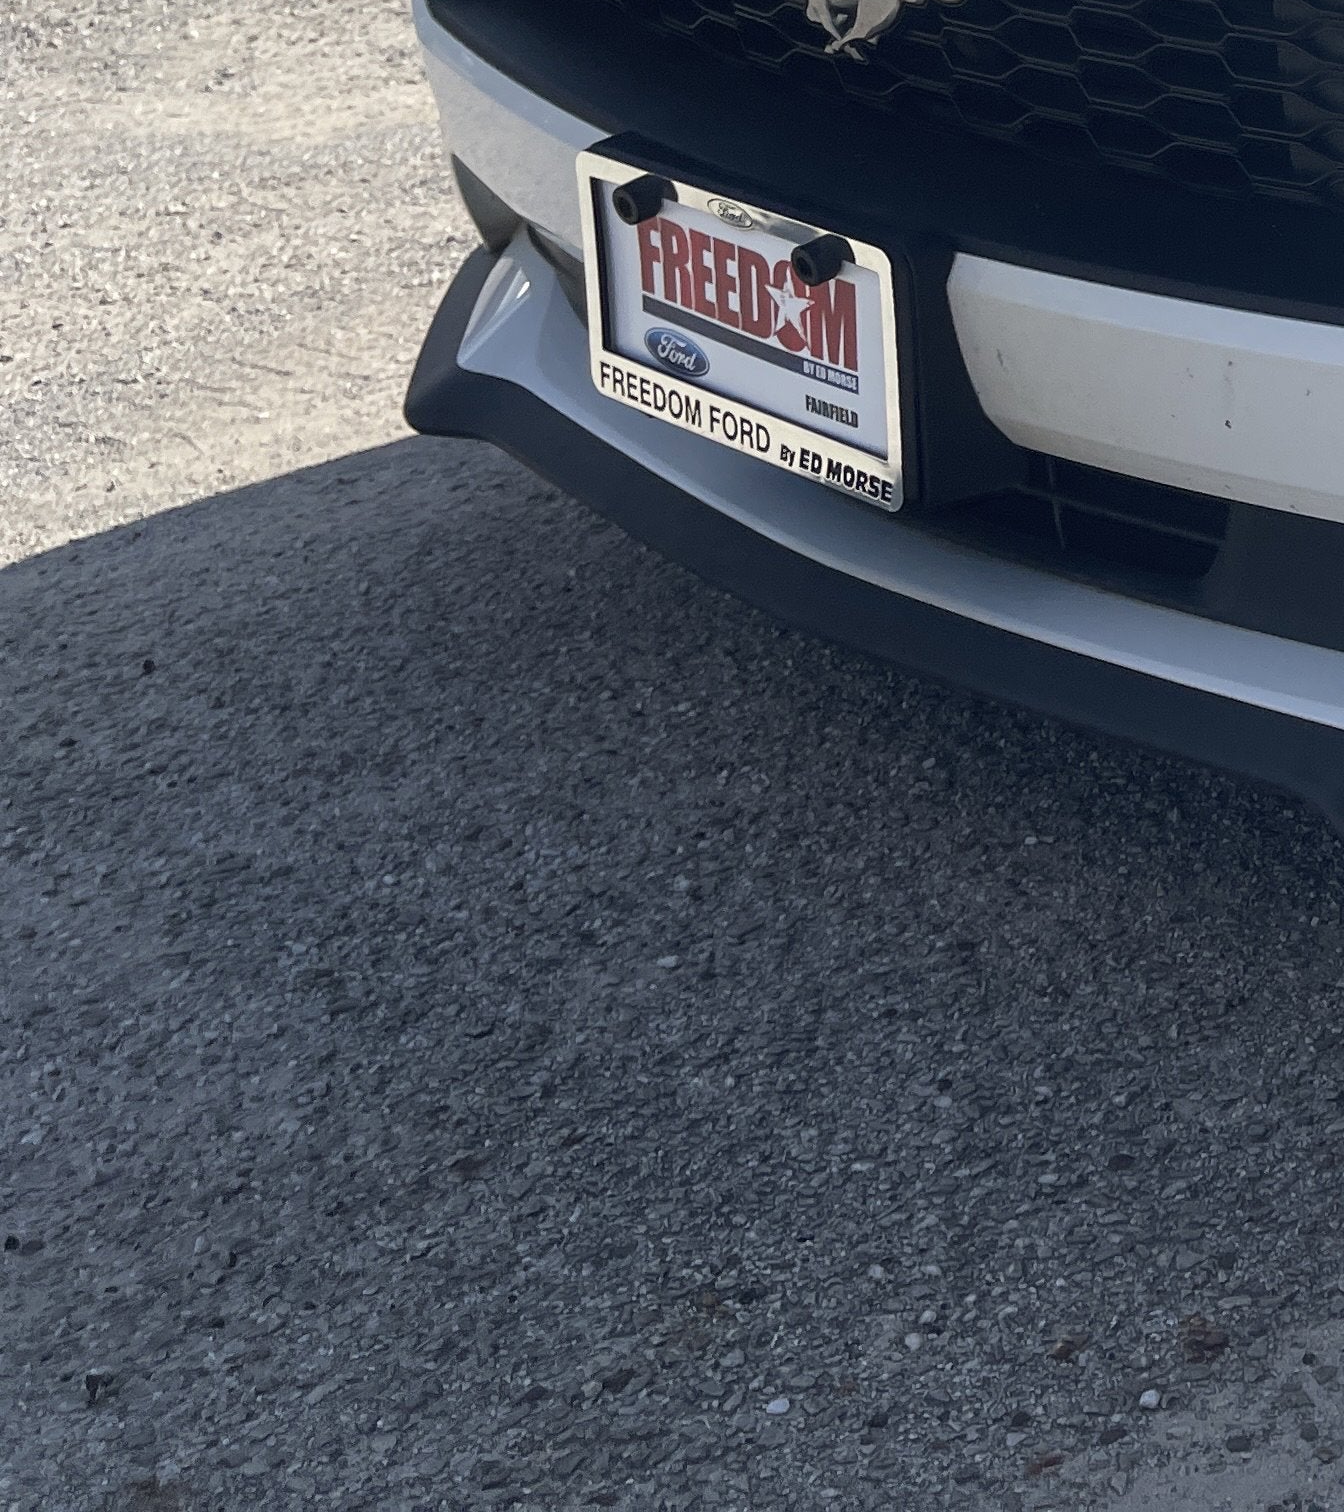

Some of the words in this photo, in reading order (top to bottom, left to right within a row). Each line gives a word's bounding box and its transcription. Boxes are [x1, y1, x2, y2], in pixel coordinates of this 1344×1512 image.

[715, 201, 748, 224] Ford
[636, 214, 859, 373] FREEDOM
[656, 336, 697, 372] Ford
[803, 360, 815, 375] BY
[815, 364, 827, 380] ED
[827, 368, 857, 391] MORSE
[805, 394, 859, 428] FAIRFIELD
[600, 362, 702, 428] FREEDOM
[709, 405, 771, 453] FORD
[799, 448, 822, 474] ED
[826, 458, 893, 503] MORSE
